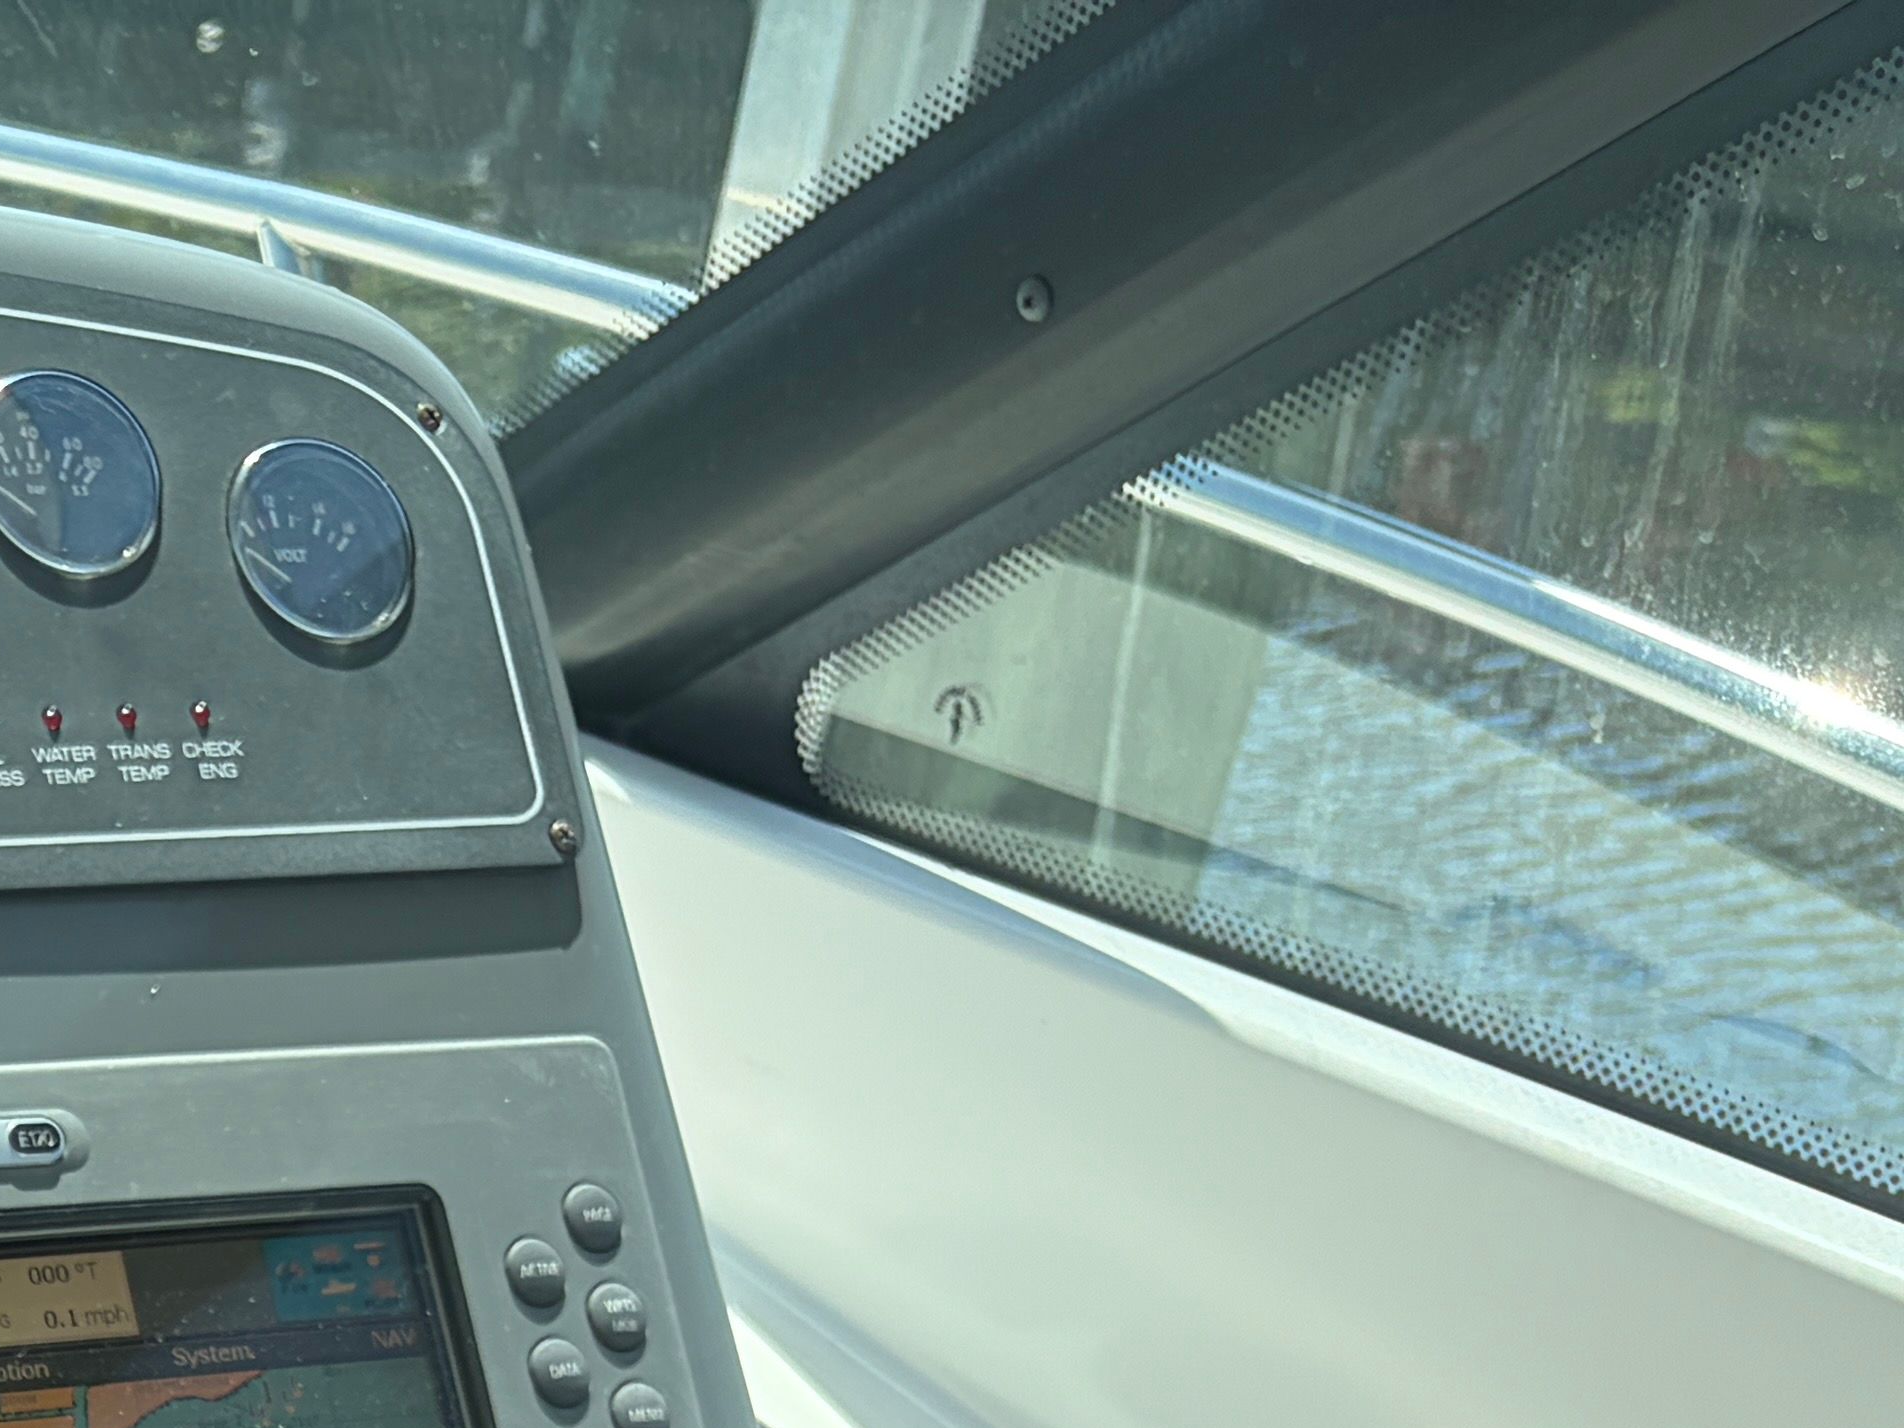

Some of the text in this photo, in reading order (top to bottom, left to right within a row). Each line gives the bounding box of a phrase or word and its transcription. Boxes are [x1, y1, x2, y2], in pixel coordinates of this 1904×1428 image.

[32, 745, 96, 763] WATER
[107, 743, 171, 760] TRANS
[182, 741, 244, 758] CHECK
[43, 767, 95, 785] TEMP
[118, 765, 170, 782] TEMP
[198, 762, 238, 780] ENG
[172, 1343, 255, 1366] System
